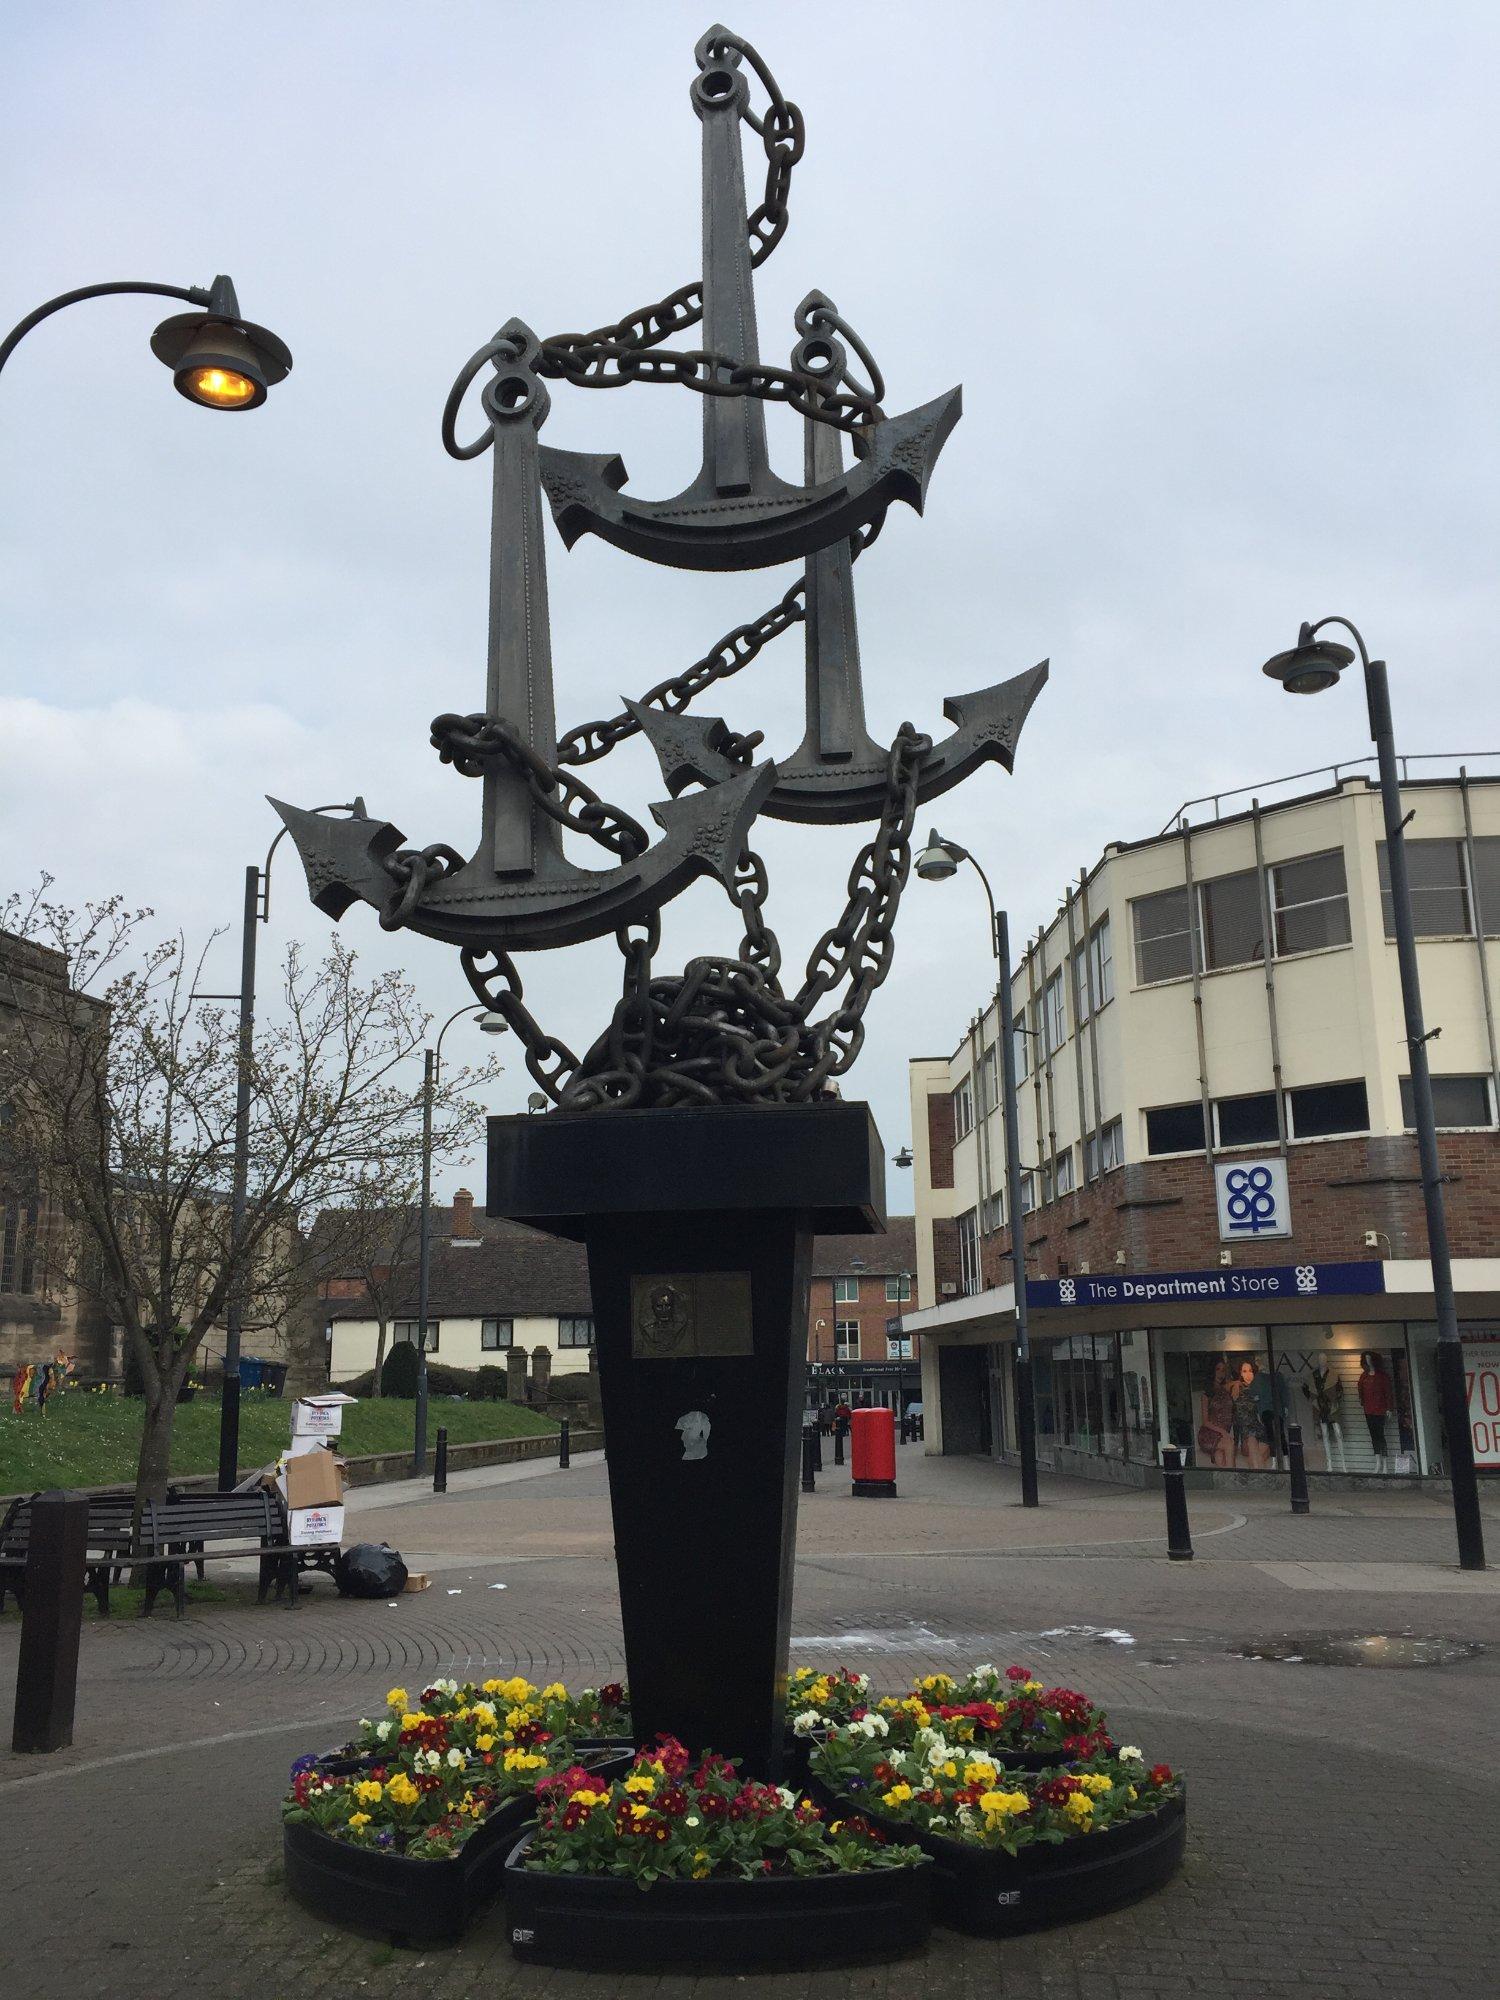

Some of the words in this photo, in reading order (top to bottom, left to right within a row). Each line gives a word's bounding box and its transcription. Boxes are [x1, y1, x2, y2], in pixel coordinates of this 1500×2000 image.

[1089, 1283, 1117, 1298] The
[1123, 1278, 1226, 1299] Department
[1232, 1275, 1280, 1292] Store
